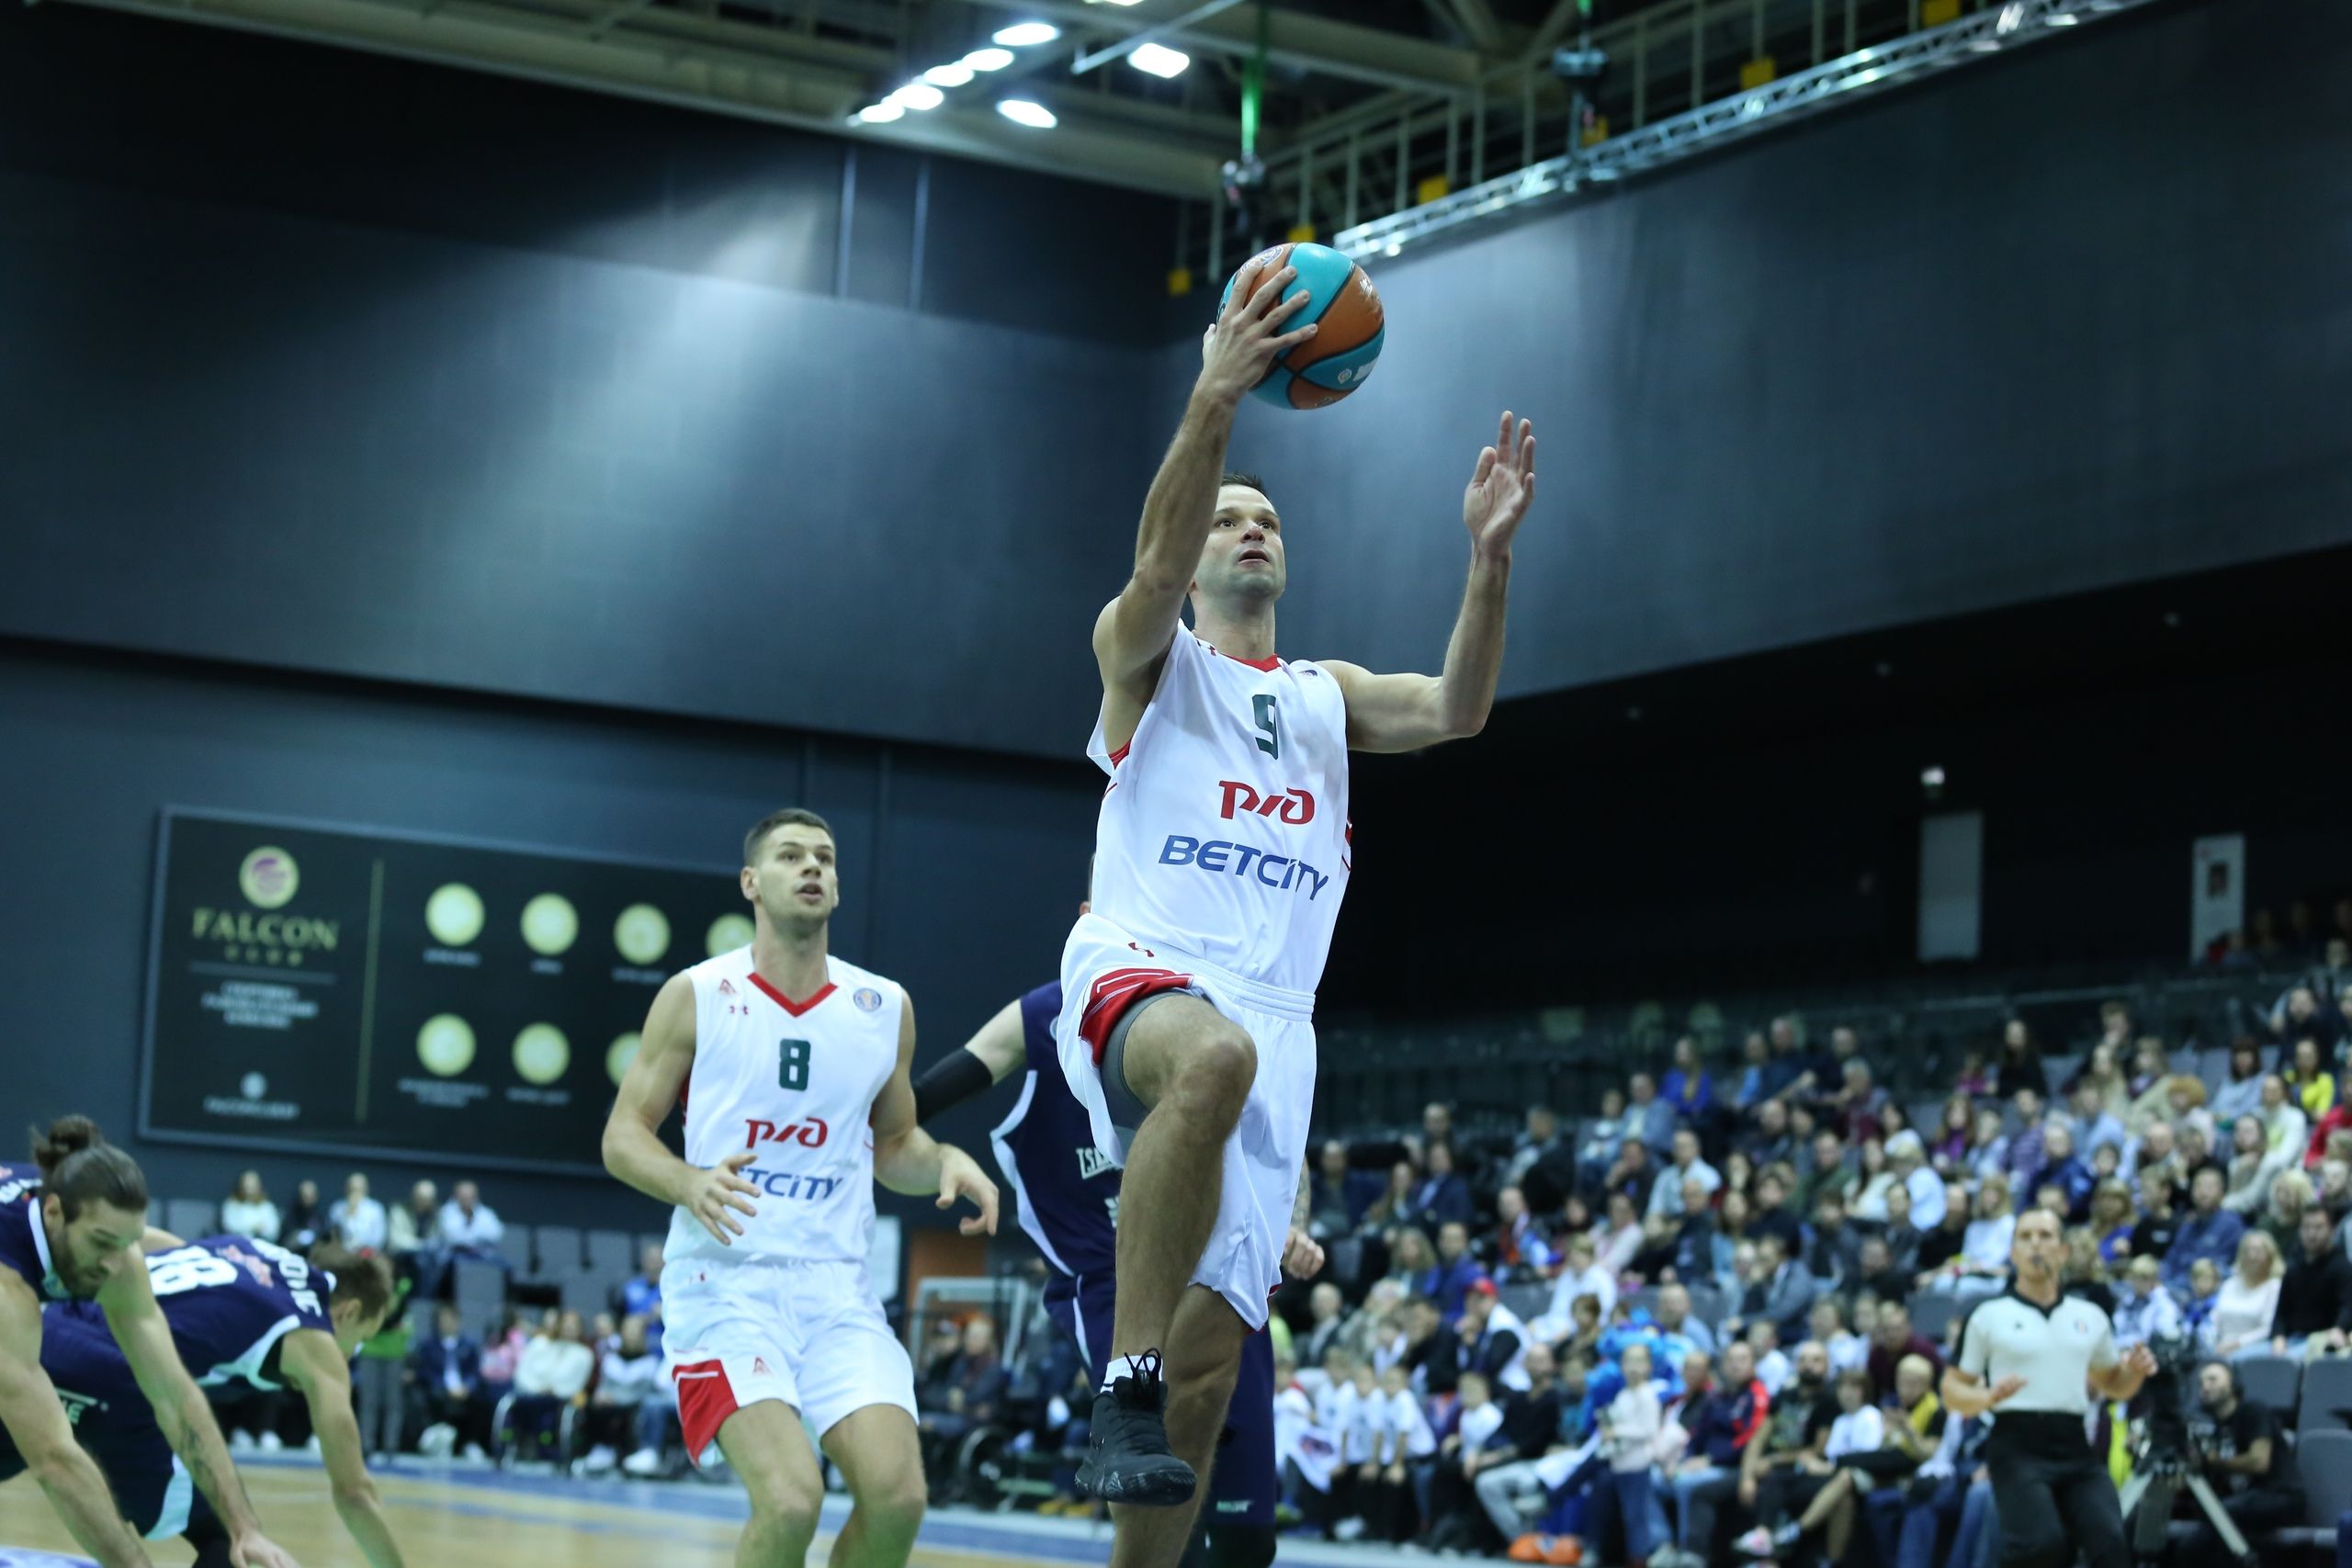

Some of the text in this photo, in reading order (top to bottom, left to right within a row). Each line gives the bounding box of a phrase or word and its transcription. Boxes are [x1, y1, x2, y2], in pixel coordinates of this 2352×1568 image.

[1252, 694, 1279, 761] 9
[192, 906, 340, 951] FALCON
[779, 1038, 811, 1092] 8
